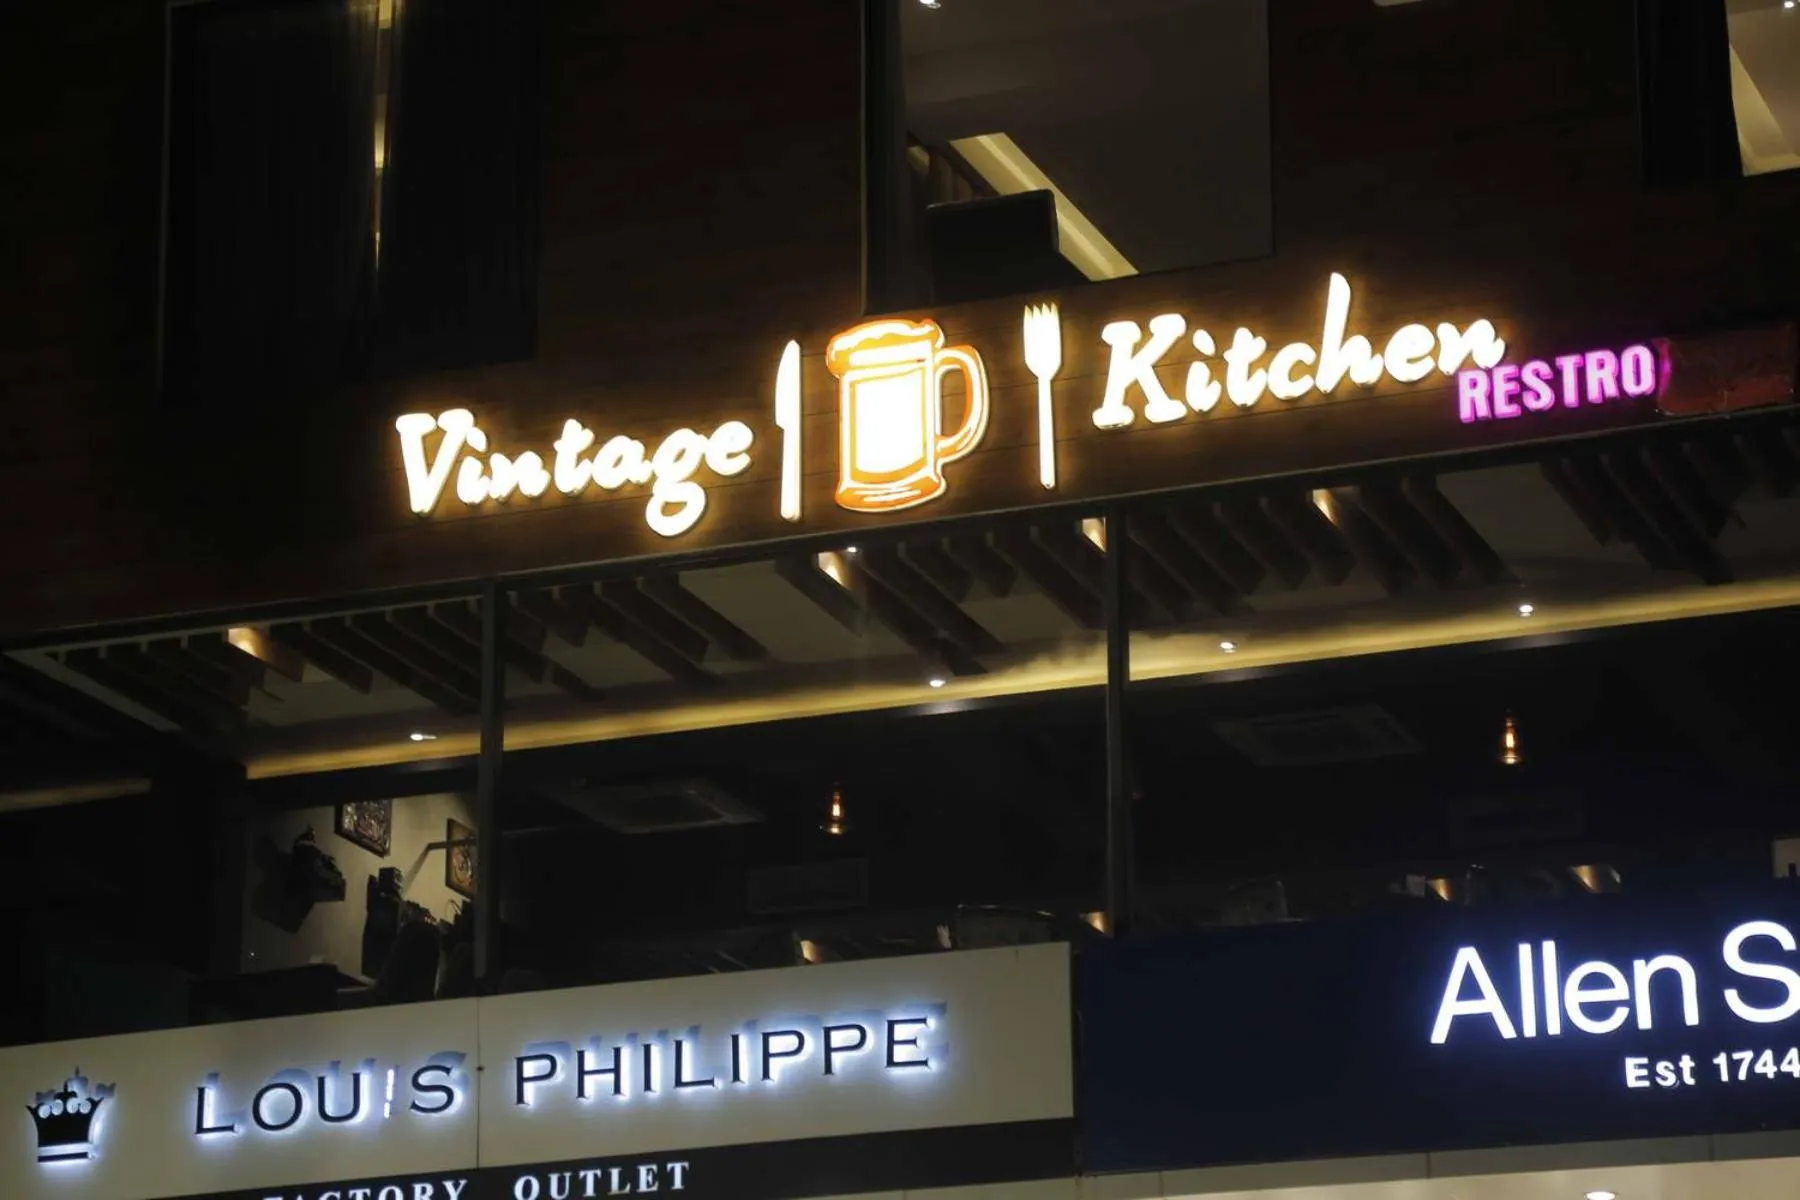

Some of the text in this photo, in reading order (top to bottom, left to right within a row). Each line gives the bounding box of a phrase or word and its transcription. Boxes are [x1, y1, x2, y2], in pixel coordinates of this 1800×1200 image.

[395, 272, 1506, 537] Vintage Kitchen
[1457, 343, 1657, 424] RESTRO
[1430, 939, 1700, 1044] Allen
[514, 1016, 931, 1105] PHILIPPE
[1624, 1047, 1800, 1088] Est 1744
[514, 1162, 690, 1200] OUTLET
